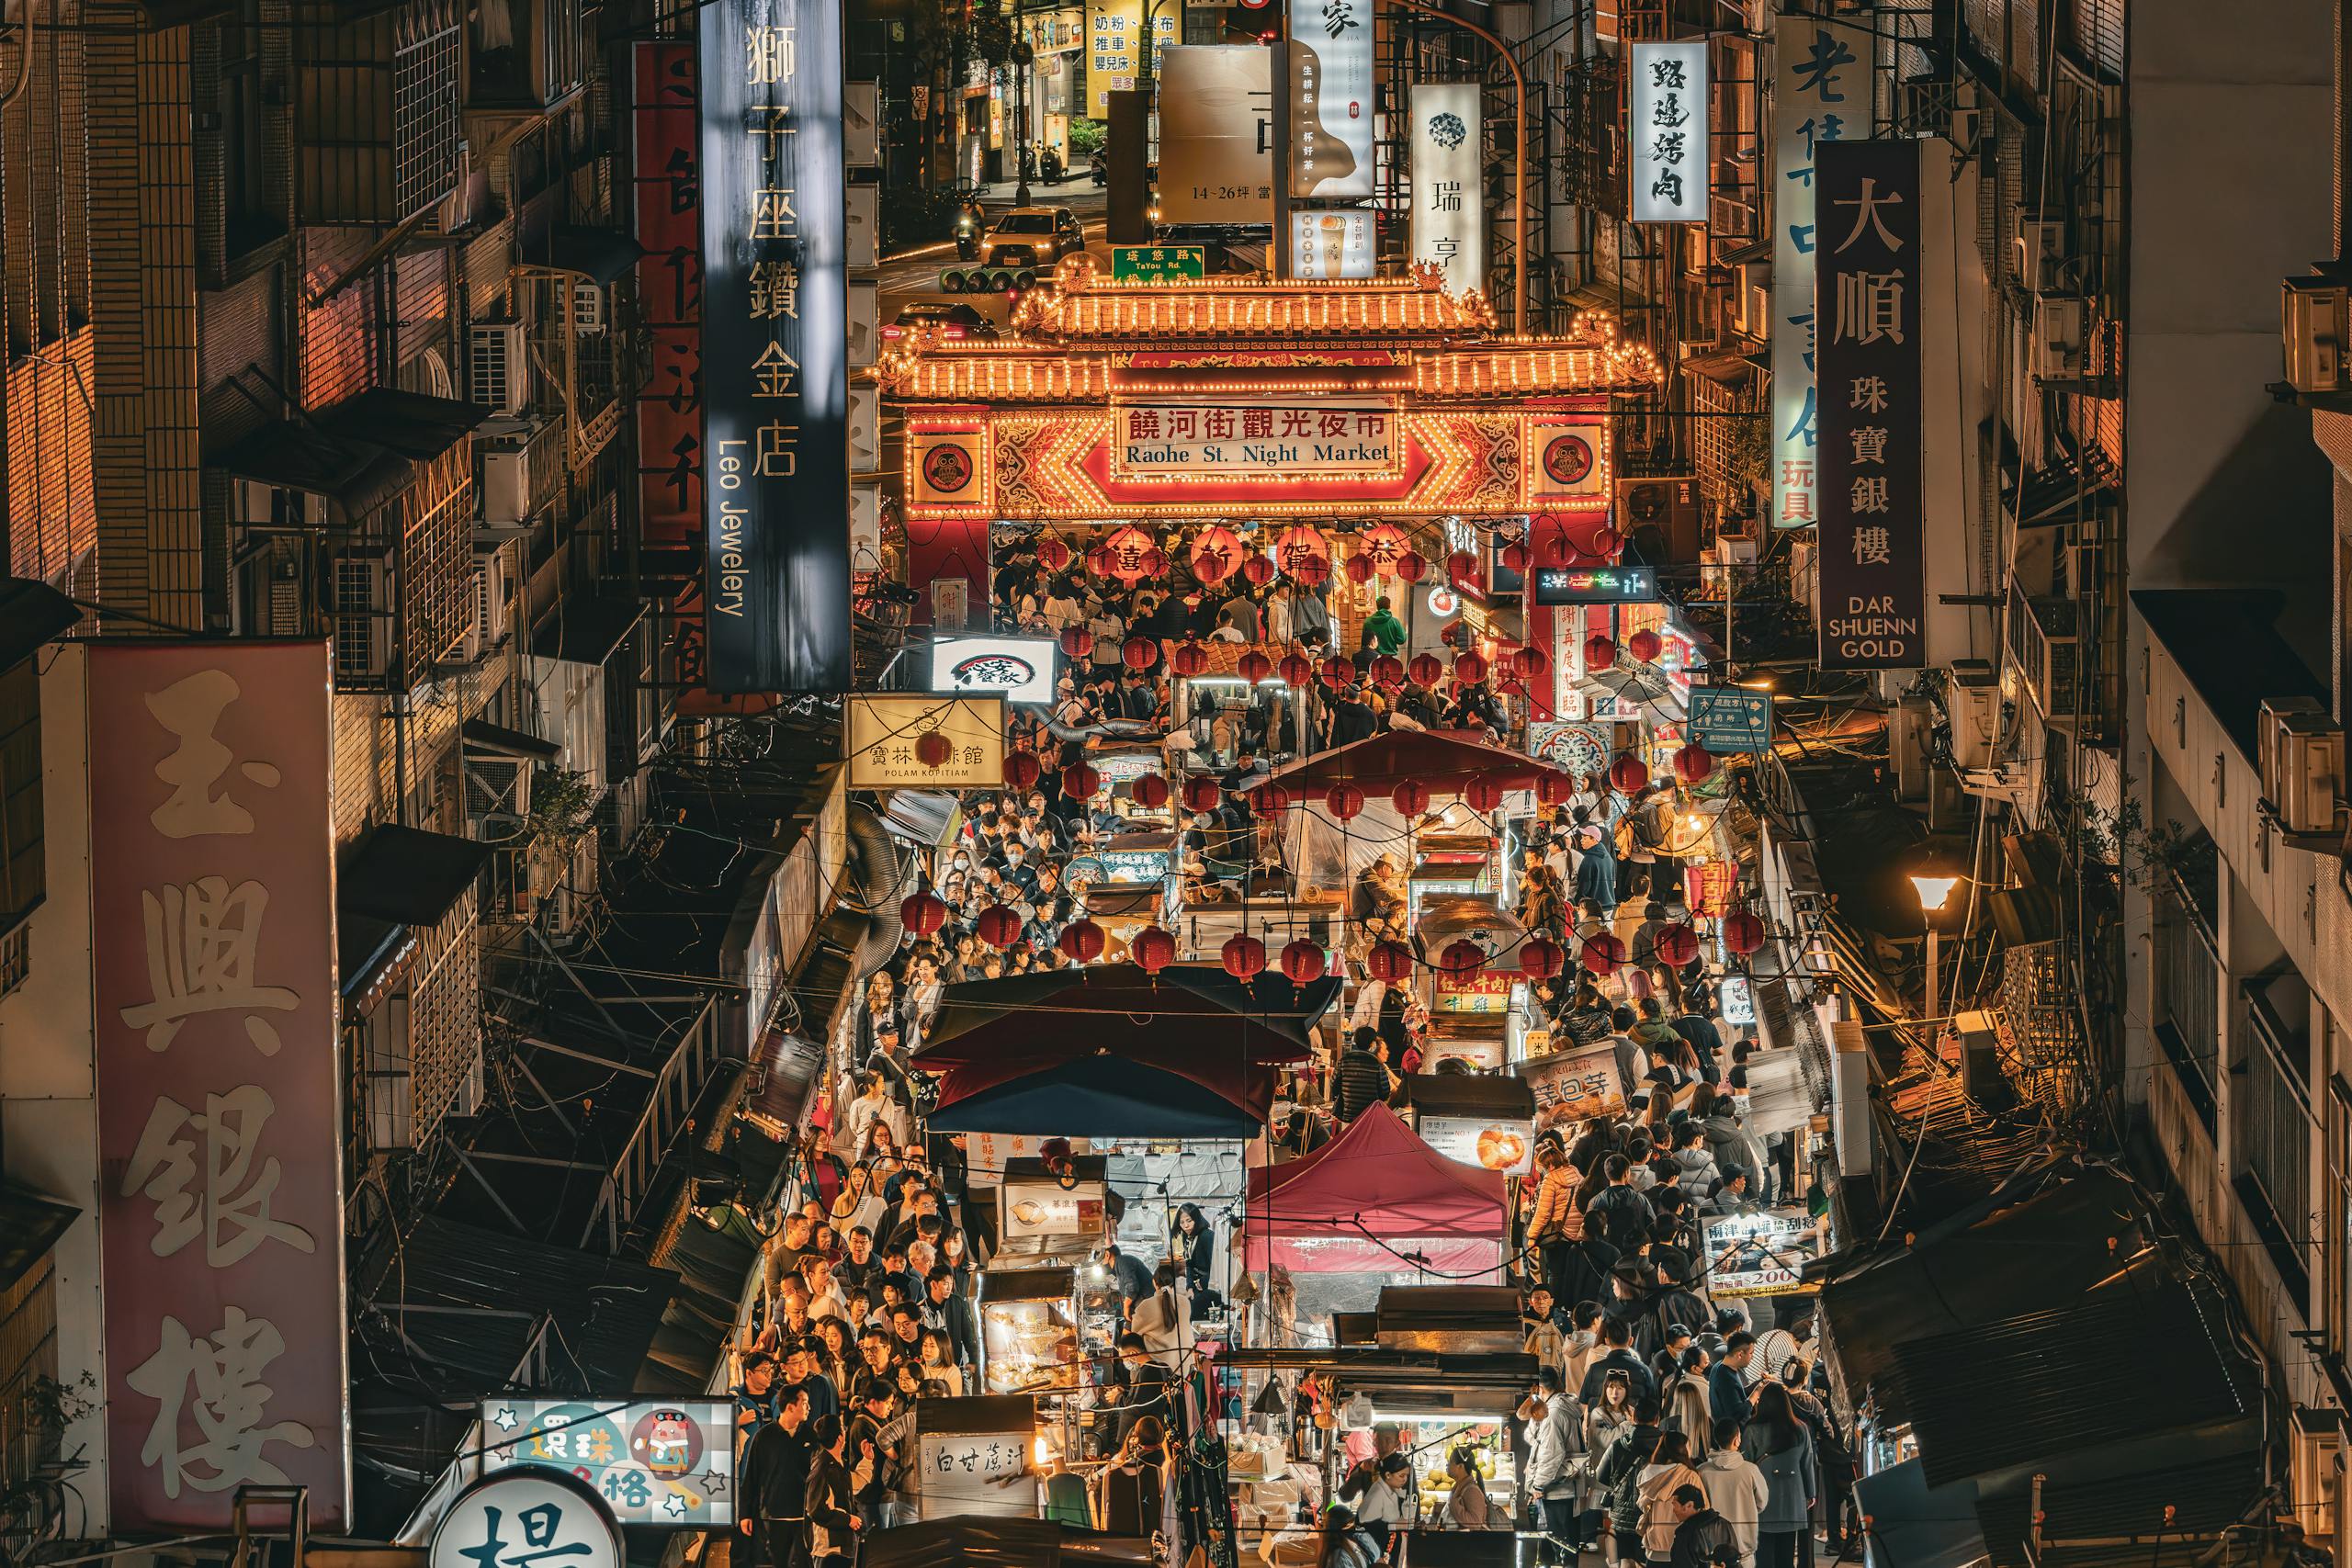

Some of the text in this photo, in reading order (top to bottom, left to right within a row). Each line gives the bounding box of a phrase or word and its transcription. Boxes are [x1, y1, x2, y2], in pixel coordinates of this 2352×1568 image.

[1650, 58, 1690, 207] 路邊烤肉
[747, 26, 799, 478] 獅子座鑽金店
[1126, 249, 1190, 262] 塔悠路
[1834, 177, 1905, 565] 大順 珠寶銀樓
[1128, 409, 1385, 440] 饒河街觀光夜市
[1126, 444, 1390, 468] Raohe St. Night Market
[715, 440, 749, 617] Leo Jewelery
[1366, 537, 1398, 563] 恭
[1849, 596, 1895, 615] DAR
[1829, 618, 1917, 637] SHUENN
[1841, 640, 1905, 659] GOLD
[869, 745, 983, 766] 寶林館
[119, 668, 316, 1500] 玉興銀樓
